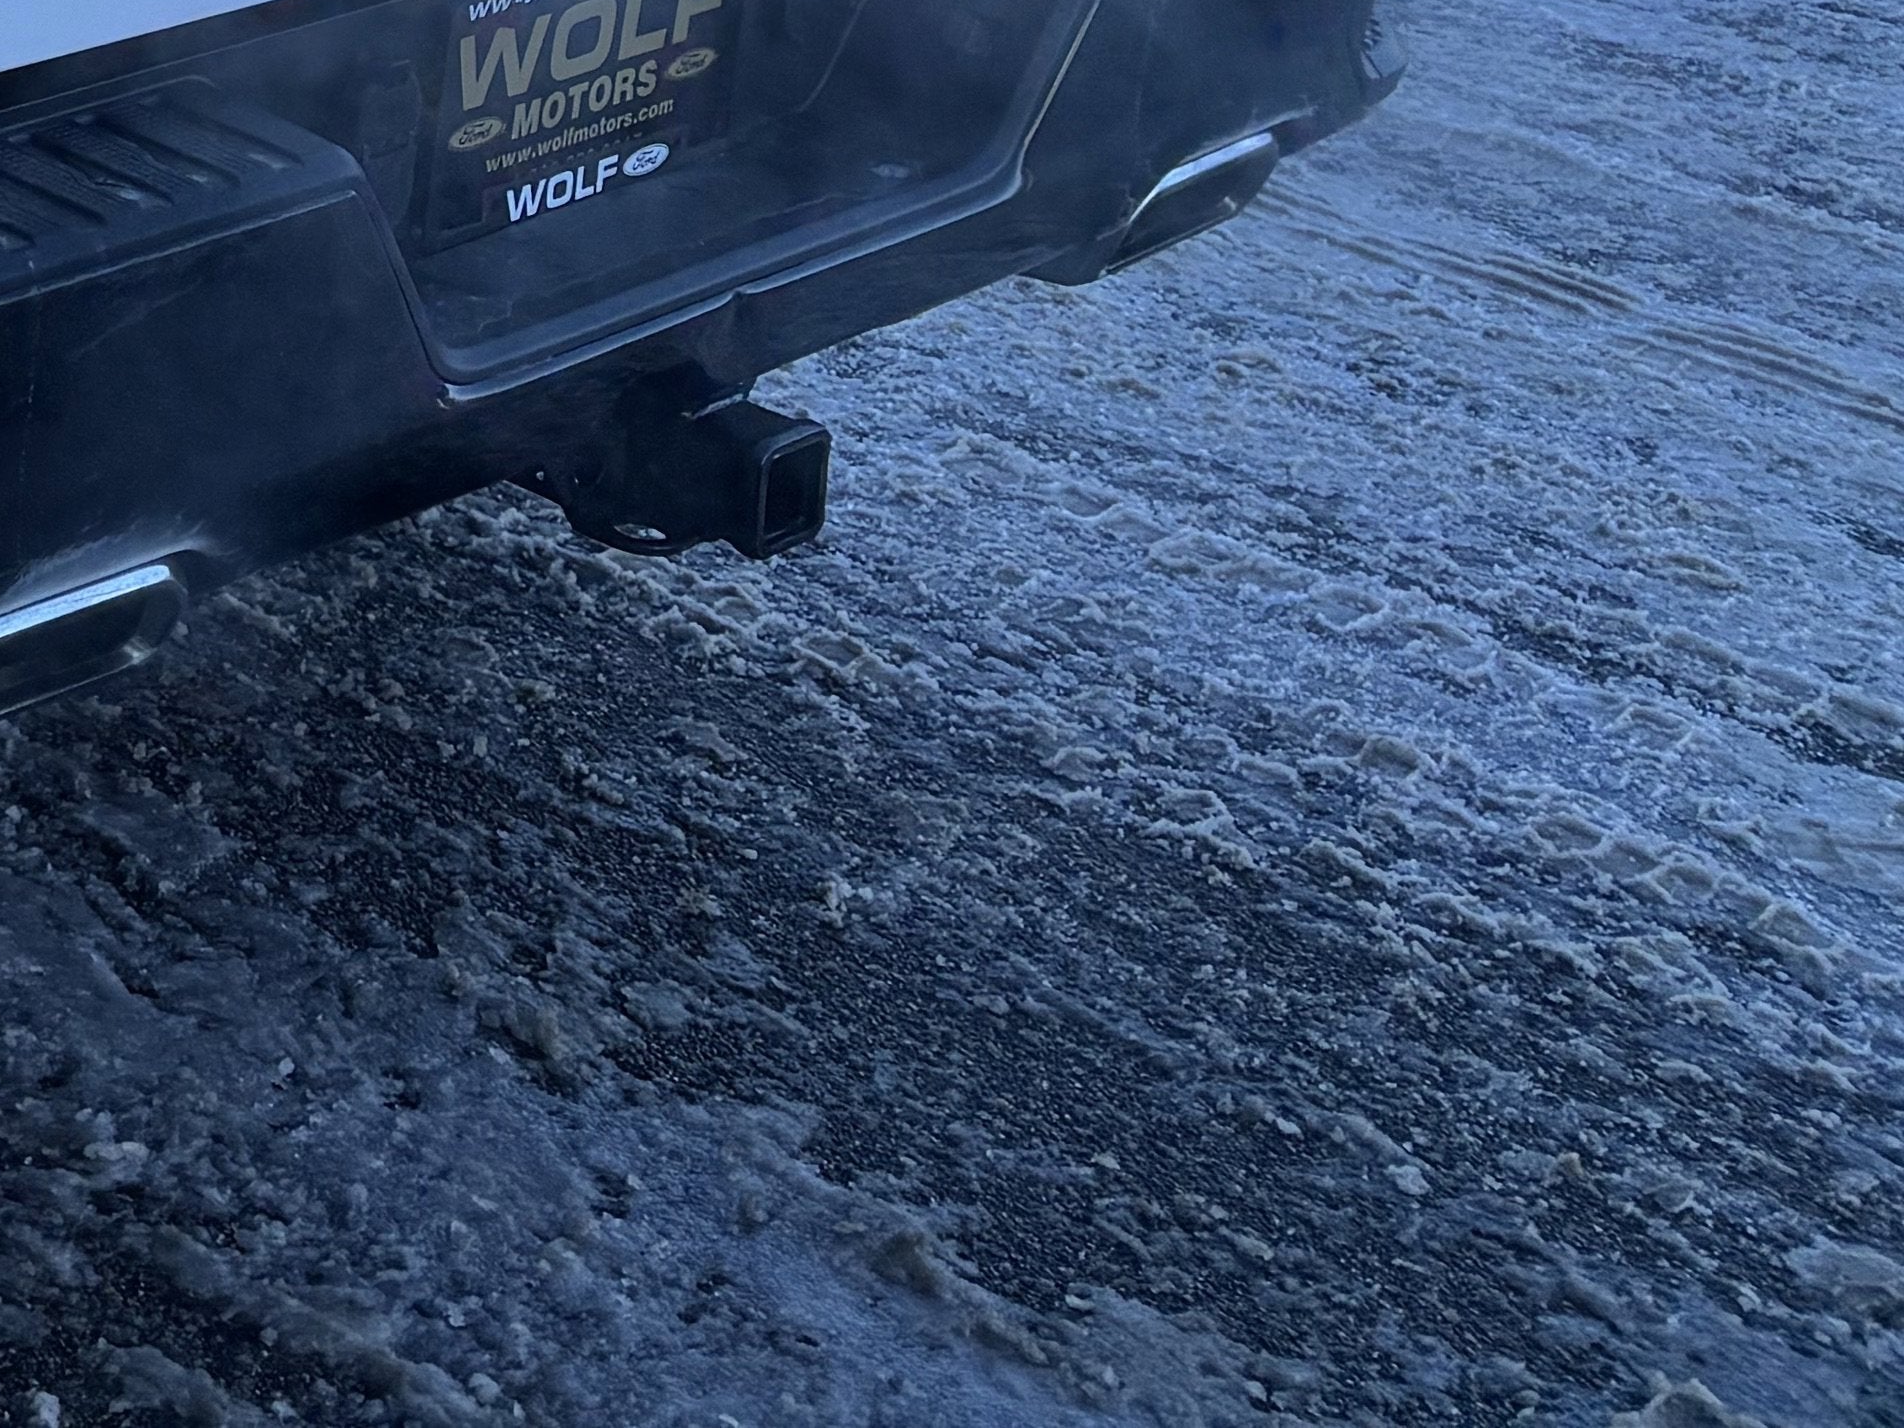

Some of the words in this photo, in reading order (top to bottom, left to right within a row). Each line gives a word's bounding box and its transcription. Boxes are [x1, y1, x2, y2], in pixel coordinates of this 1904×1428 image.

[485, 98, 675, 174] www.wolfmotors.com
[511, 59, 659, 141] MOTORS
[506, 154, 620, 223] WOLF
